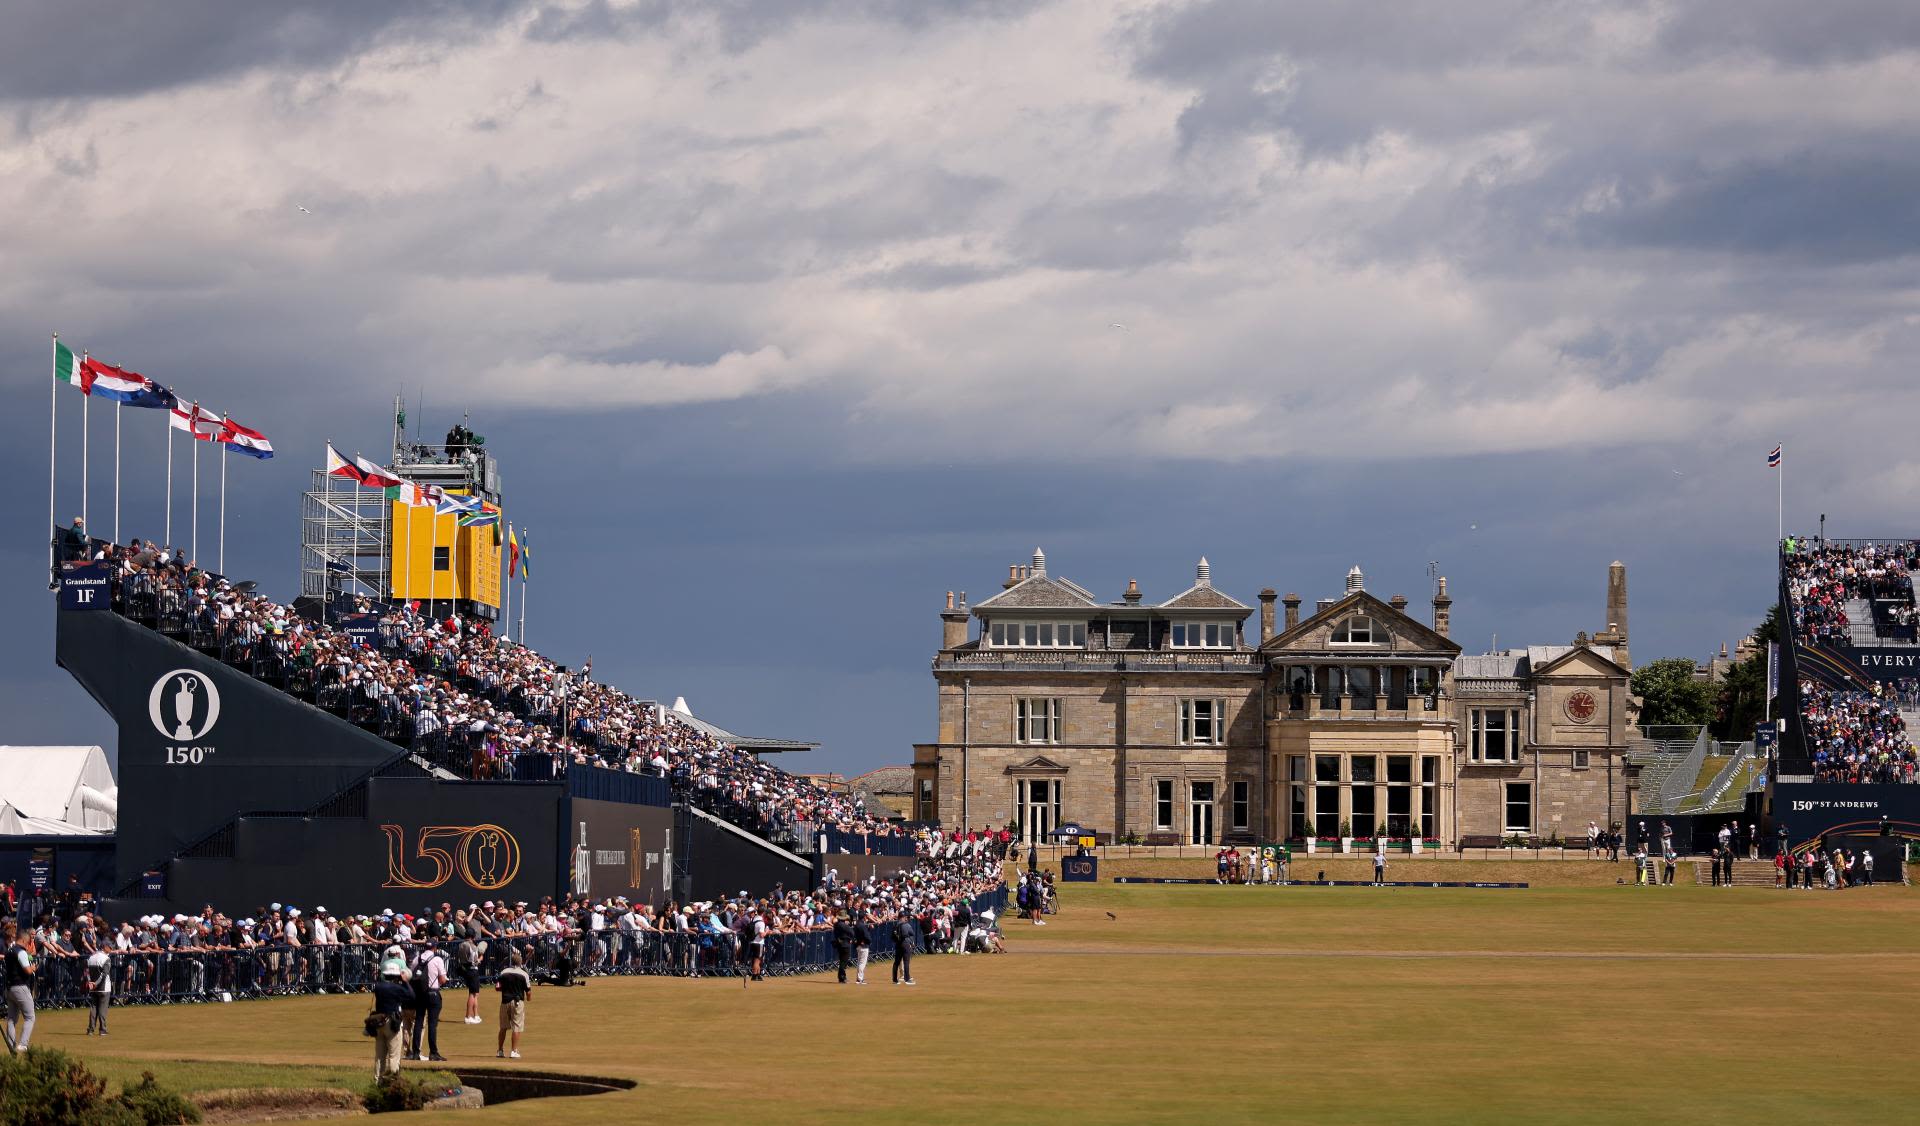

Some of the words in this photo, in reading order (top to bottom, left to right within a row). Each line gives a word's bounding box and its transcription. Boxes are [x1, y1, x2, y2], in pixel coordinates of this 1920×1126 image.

[65, 577, 106, 585] Grandstand
[77, 589, 95, 603] 1F
[1860, 654, 1920, 666] EVERY
[380, 823, 521, 890] 150
